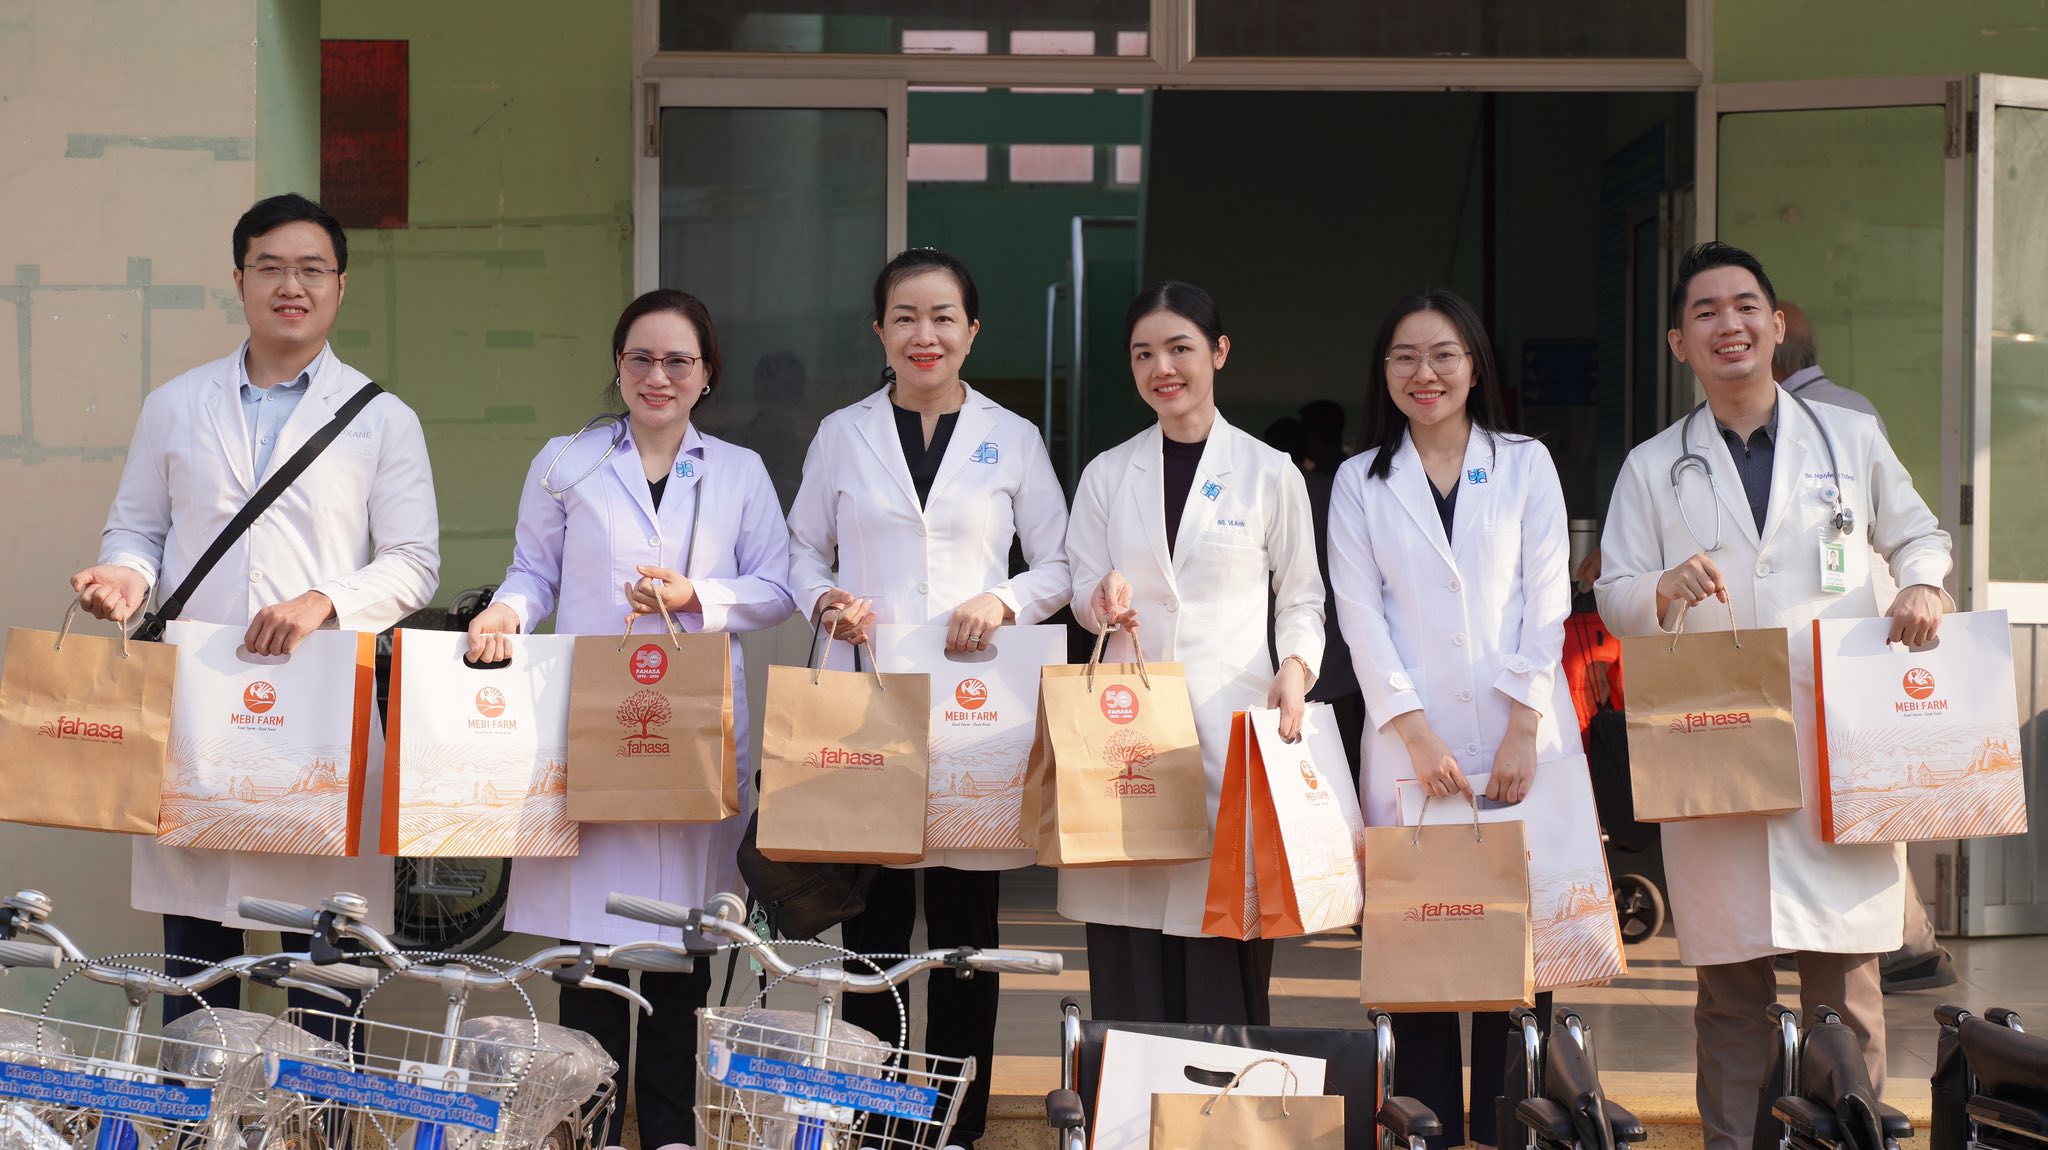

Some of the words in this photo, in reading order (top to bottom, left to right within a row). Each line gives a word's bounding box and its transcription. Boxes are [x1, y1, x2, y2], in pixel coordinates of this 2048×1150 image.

[636, 650, 662, 669] 50
[1106, 691, 1132, 709] 50
[1895, 701, 1919, 713] MEBI
[1921, 699, 1948, 710] FARM
[230, 712, 255, 725] MEBI
[257, 715, 285, 727] FARM
[467, 718, 490, 729] MEBI
[492, 719, 517, 730] FARM
[945, 710, 969, 722] MEBI
[971, 710, 998, 722] FARM
[1685, 712, 1752, 733] fahasa
[57, 716, 124, 739] fahasa
[627, 740, 670, 758] fahasa
[820, 747, 885, 769] fahasa
[1114, 781, 1156, 798] fahasa
[1421, 902, 1485, 922] fahasa
[6, 1065, 41, 1082] Khoa
[301, 1064, 336, 1082] Khoa
[749, 1058, 785, 1076] Khoa
[22, 1083, 51, 1100] viện
[53, 1087, 77, 1103] Đại
[79, 1091, 106, 1107] Học
[107, 1094, 119, 1107] Y
[156, 1102, 207, 1116] TPHCM
[282, 1074, 316, 1092] Bệnh
[317, 1083, 346, 1100] viện
[347, 1088, 371, 1106] Đại
[372, 1092, 399, 1110] Học
[399, 1098, 410, 1111] Y
[447, 1107, 494, 1129] TPHCM
[729, 1070, 763, 1087] Bệnh
[765, 1077, 793, 1094] viện
[795, 1081, 820, 1099] Đại
[820, 1085, 847, 1104] Học
[847, 1091, 860, 1104] Y
[895, 1101, 933, 1118] TPHC
